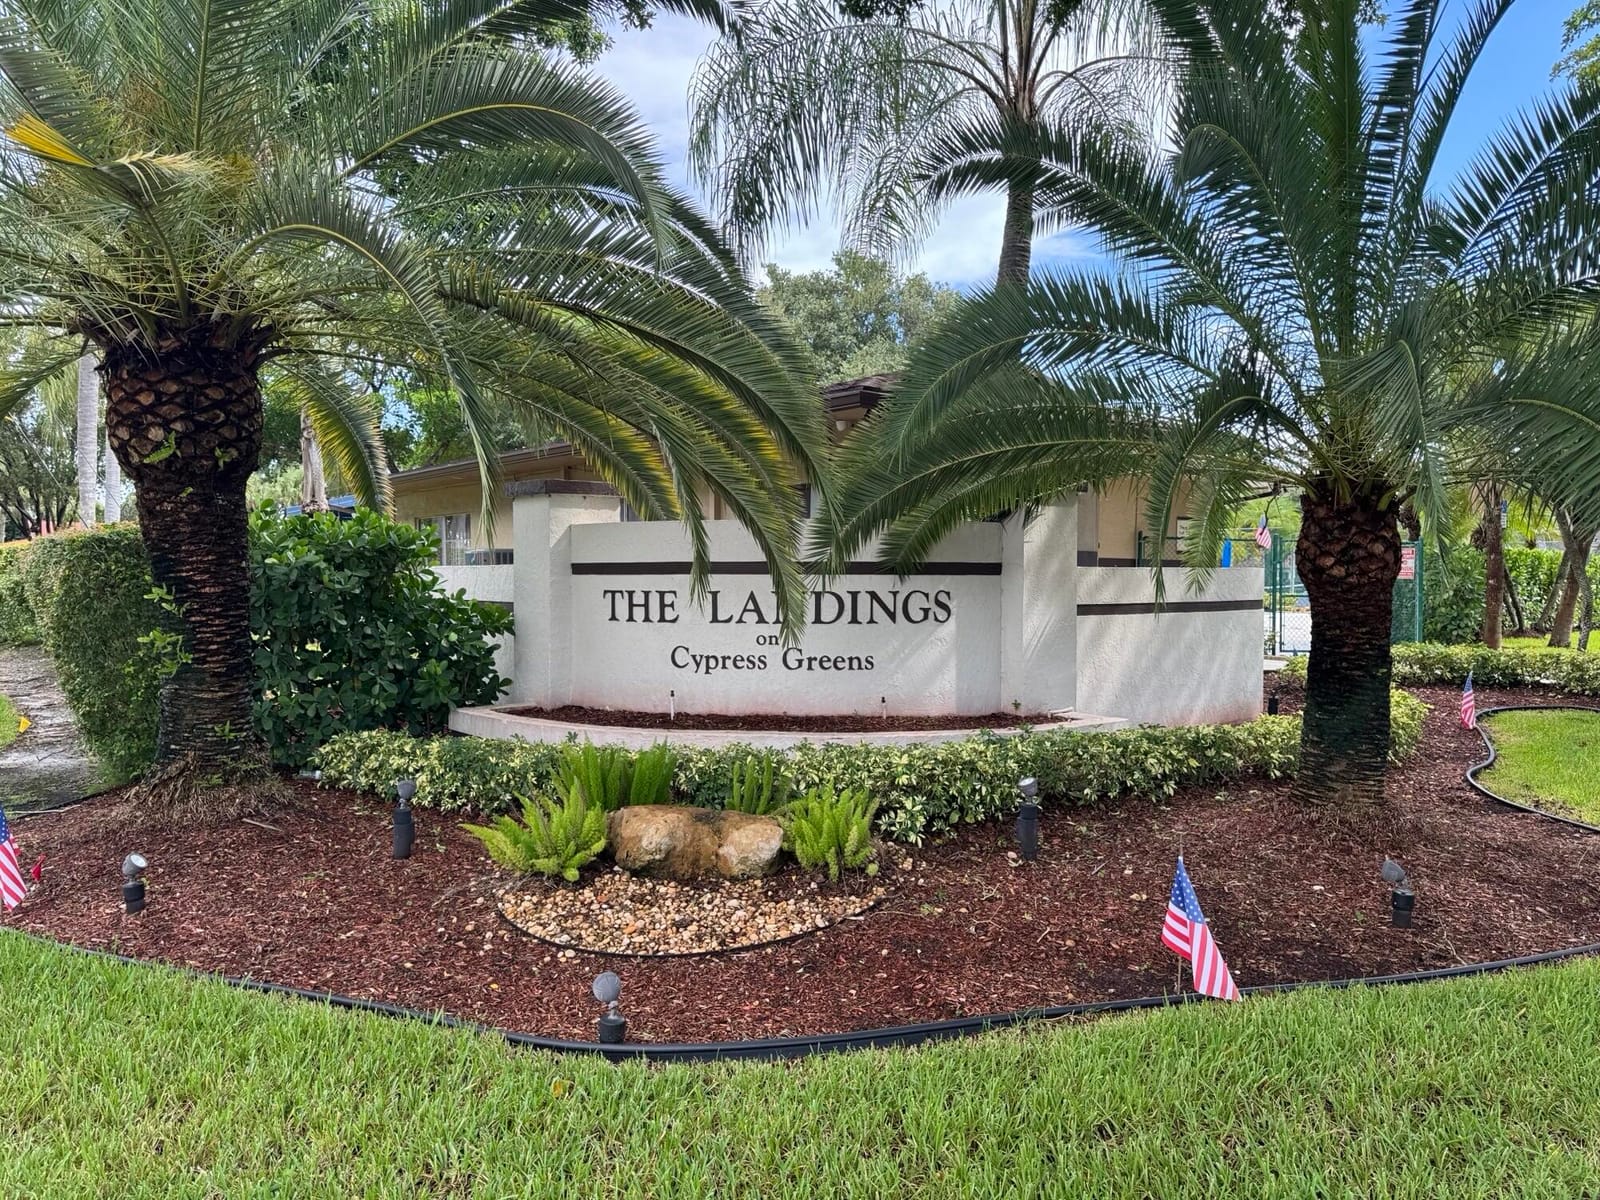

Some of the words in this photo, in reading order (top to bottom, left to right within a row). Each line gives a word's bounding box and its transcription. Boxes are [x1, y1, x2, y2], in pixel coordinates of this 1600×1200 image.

[603, 589, 679, 624] THE
[756, 634, 780, 646] on
[671, 646, 768, 675] Cypress
[782, 647, 875, 671] Greens
